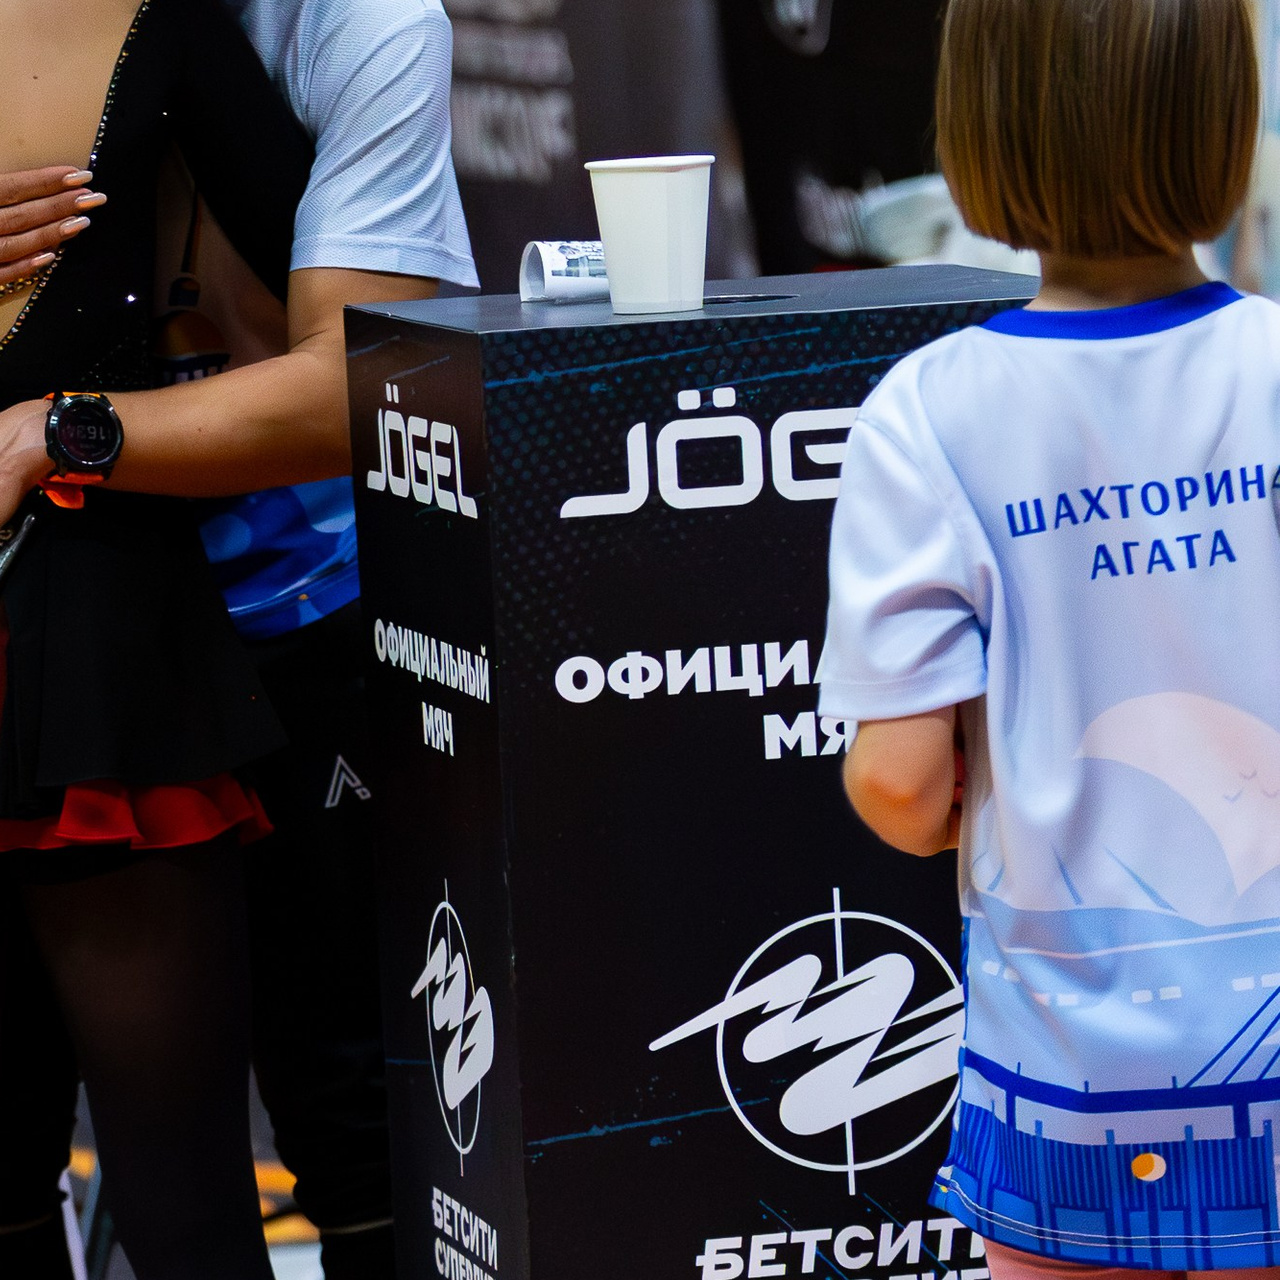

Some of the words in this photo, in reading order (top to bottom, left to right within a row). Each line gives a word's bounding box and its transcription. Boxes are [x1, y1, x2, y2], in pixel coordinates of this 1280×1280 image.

[366, 383, 478, 519] JÖGEL
[1005, 464, 1280, 538] ШАХТОРИН
[1090, 528, 1237, 580] АГАТА
[374, 618, 490, 704] ОФИЦИАЛЬНЫЙ
[554, 639, 821, 704] ОФИЦИ
[421, 701, 455, 757] МЯЧ
[431, 1185, 498, 1271] БЕТСИТИ
